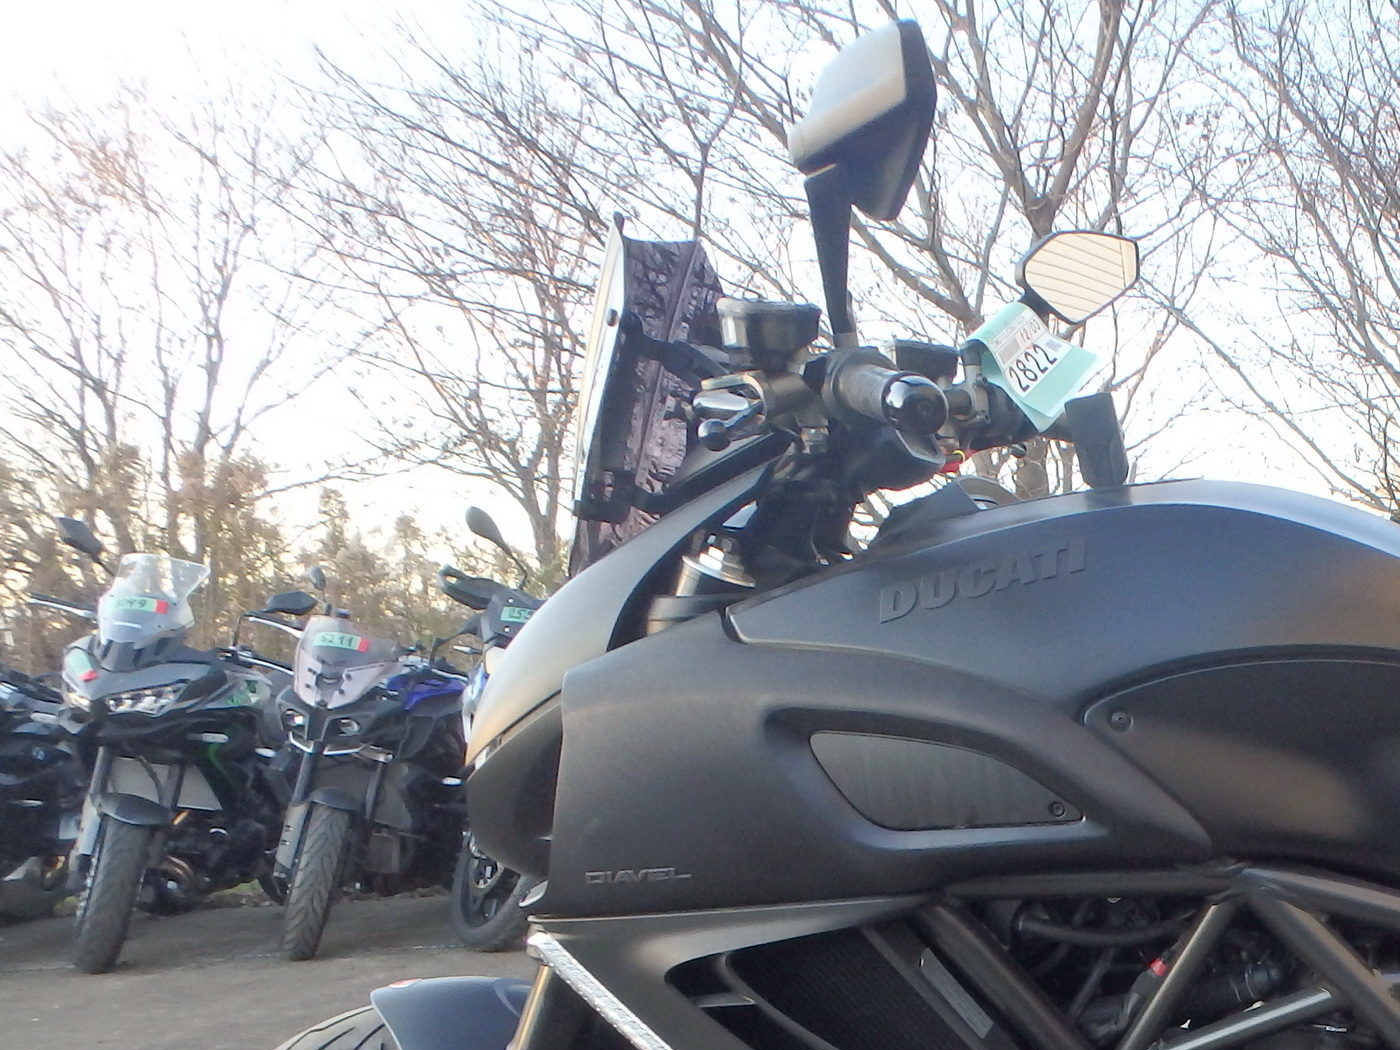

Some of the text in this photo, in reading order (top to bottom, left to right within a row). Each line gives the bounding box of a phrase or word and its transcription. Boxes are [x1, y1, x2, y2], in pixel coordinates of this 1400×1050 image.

[1020, 318, 1041, 343] 12/03
[1008, 343, 1058, 393] 2822
[879, 538, 1087, 624] DUCATI
[585, 867, 692, 884] DIAVEL
